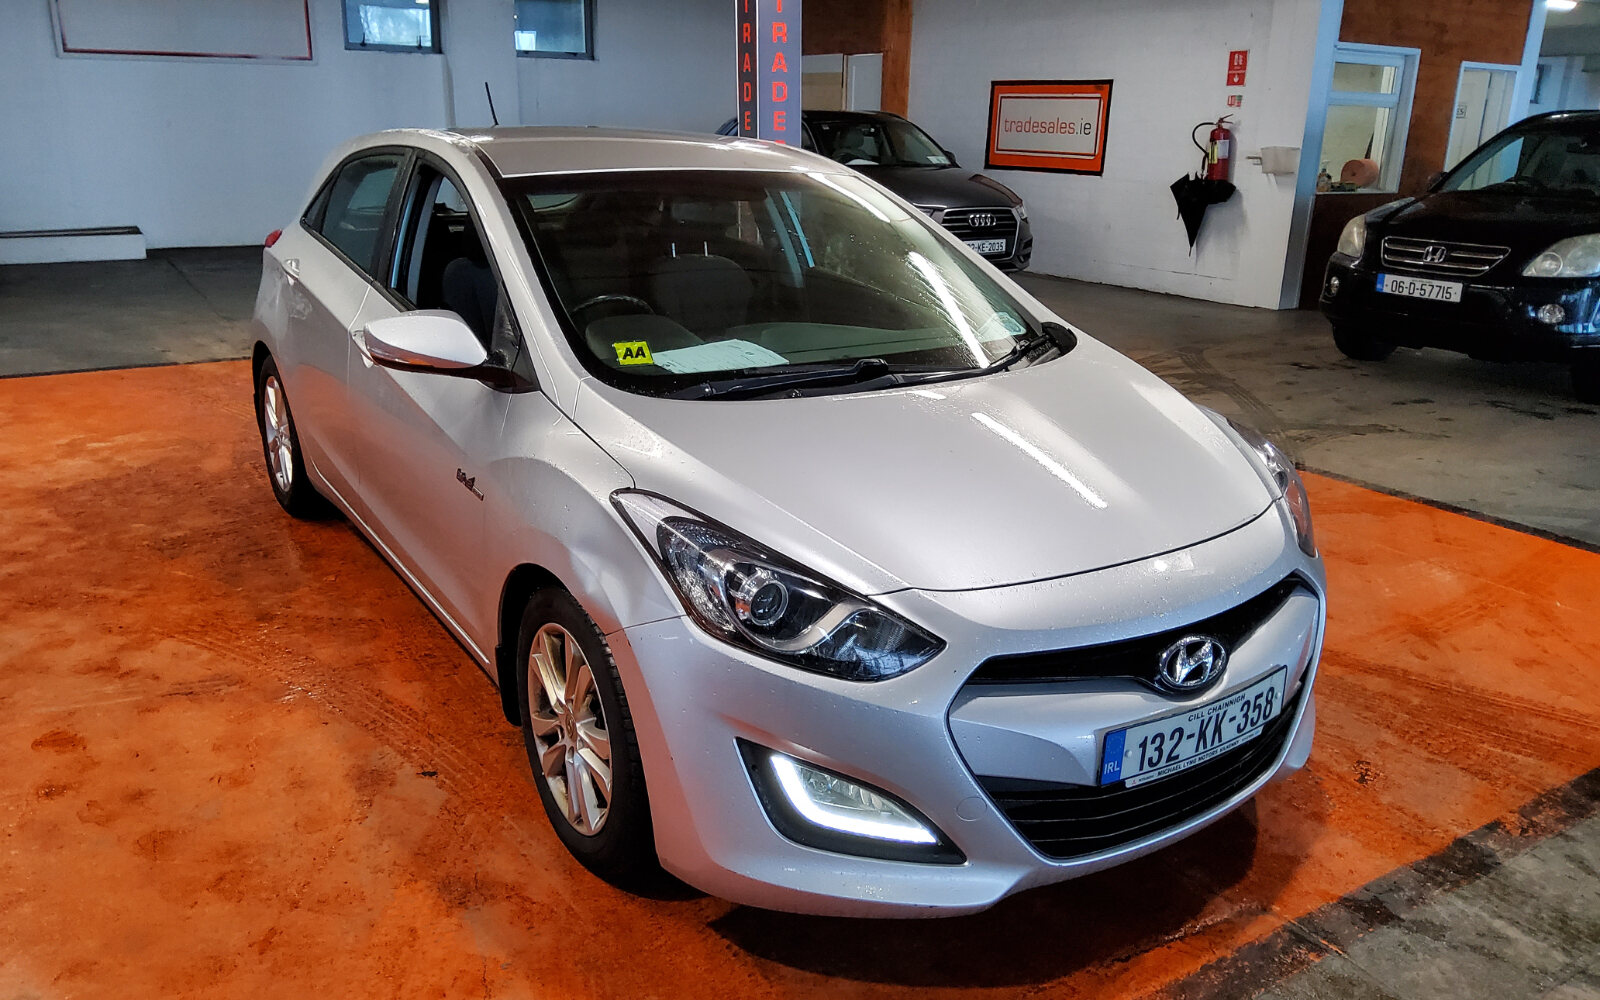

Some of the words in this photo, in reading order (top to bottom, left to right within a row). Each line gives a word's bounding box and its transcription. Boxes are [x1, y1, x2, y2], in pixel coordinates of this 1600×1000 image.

[771, 0, 788, 144] RADE
[1004, 116, 1092, 136] tradesales.ie
[1390, 279, 1453, 300] 06-D-57715
[622, 346, 646, 360] AA
[1188, 709, 1205, 722] CILL
[1207, 693, 1246, 715] CHAINNIGH
[1138, 686, 1275, 772] 132-KK-358
[1103, 760, 1120, 775] IRL
[1157, 764, 1182, 777] MICHAEL
[1198, 749, 1218, 761] MOTORS
